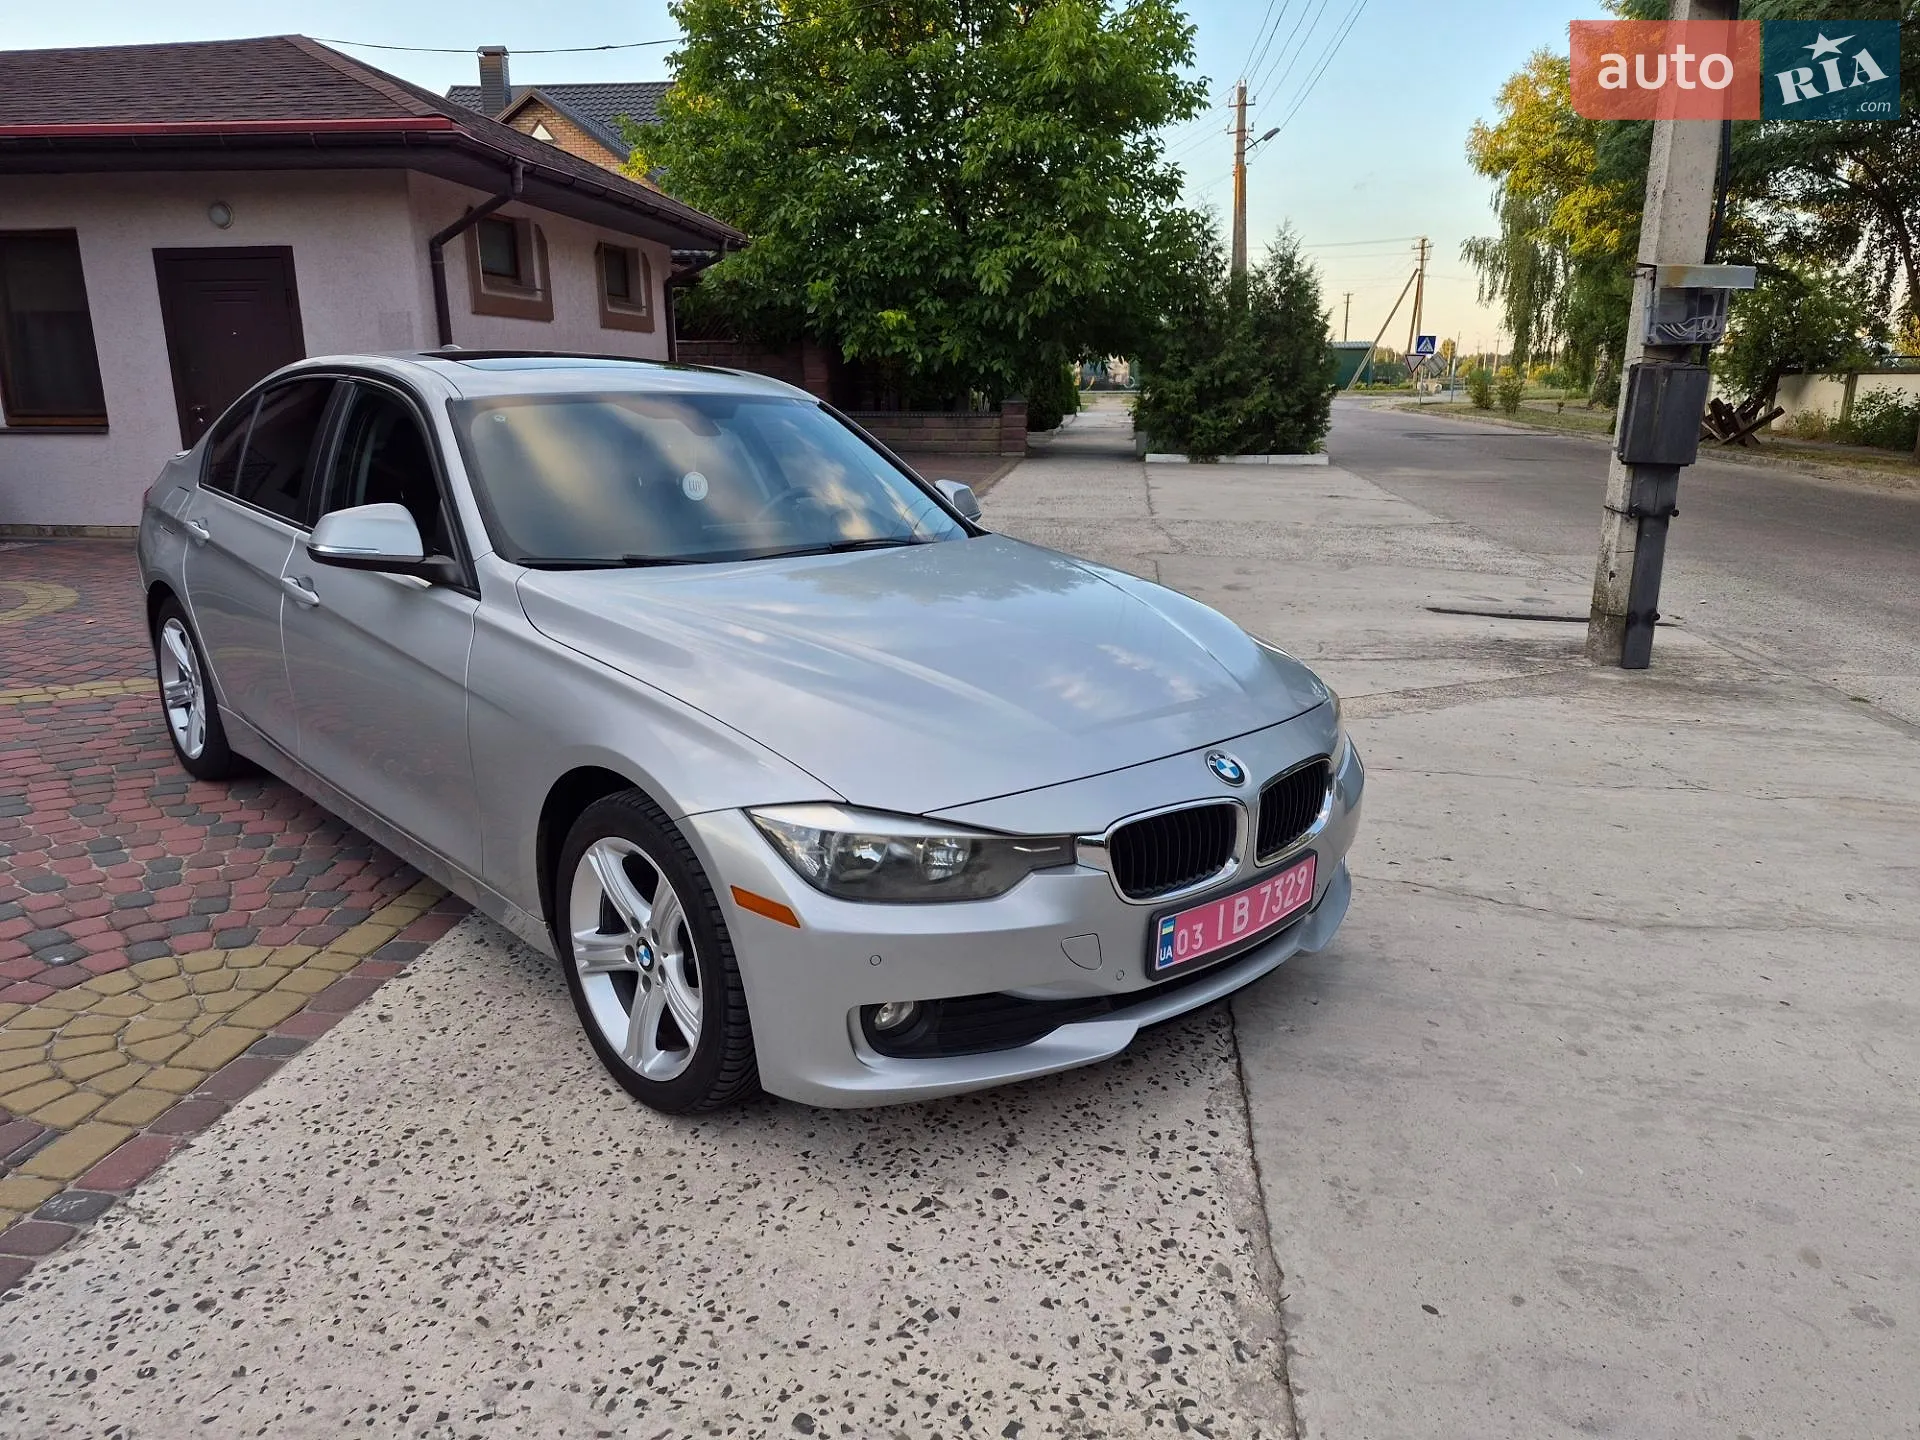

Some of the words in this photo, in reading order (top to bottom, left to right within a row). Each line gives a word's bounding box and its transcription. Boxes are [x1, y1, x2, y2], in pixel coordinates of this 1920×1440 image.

[1177, 922, 1204, 955] 03
[1260, 866, 1308, 922] 7329
[1160, 945, 1173, 961] UA
